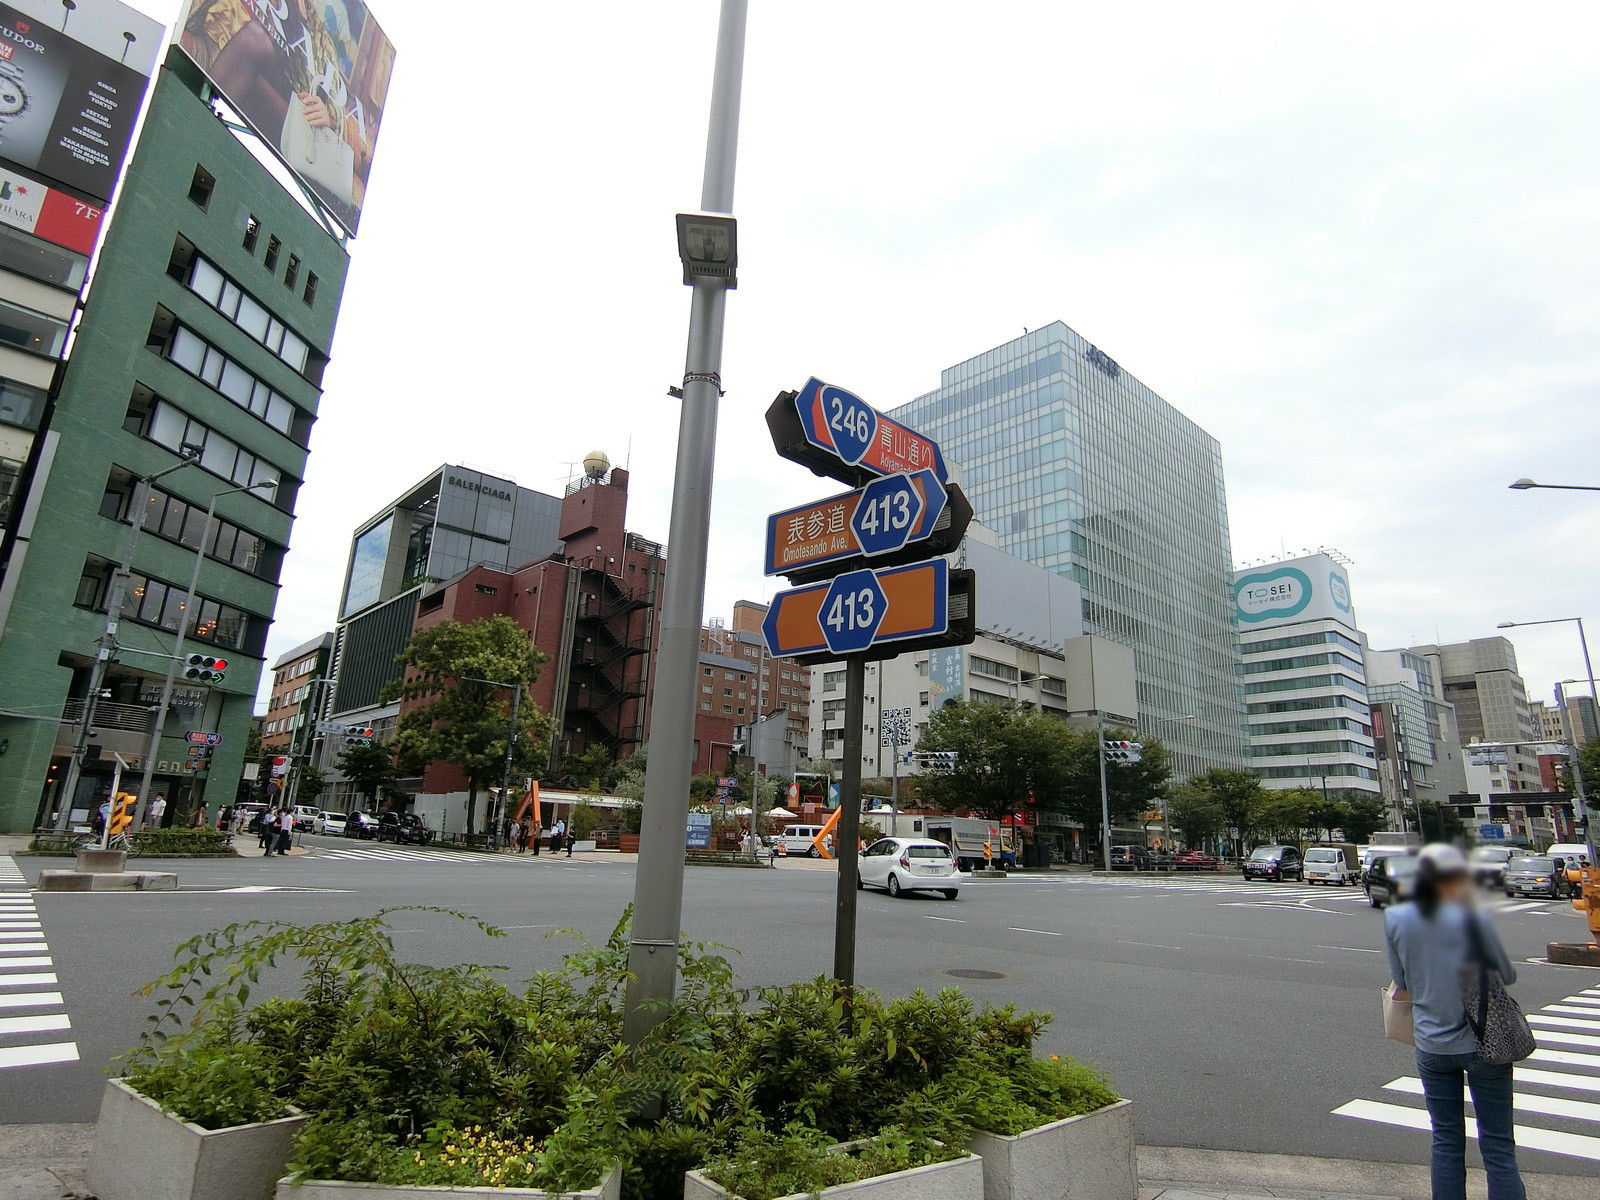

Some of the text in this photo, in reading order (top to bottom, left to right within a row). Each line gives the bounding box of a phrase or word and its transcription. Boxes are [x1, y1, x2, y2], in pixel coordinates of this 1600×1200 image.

[0, 25, 45, 54] UDOR
[244, 0, 290, 57] ALLERIA
[88, 90, 118, 108] DAIMARU
[97, 81, 117, 94] GINZA
[86, 108, 109, 122] ISETAN
[91, 97, 113, 110] TOKYO
[80, 111, 112, 129] SHINJUKU
[82, 126, 102, 138] SEIBU
[60, 140, 110, 166] WATCH MAISON
[63, 136, 109, 160] TAKASHIMAYA
[72, 151, 95, 165] TOKYO
[75, 201, 101, 220] 7F
[831, 397, 869, 443] 246
[880, 423, 932, 469] 青山通り
[880, 451, 918, 474] Aoyama-d
[448, 475, 511, 502] BALENCIAGA
[787, 503, 846, 545] 表参道
[861, 490, 910, 536] 413
[783, 536, 848, 563] Omotesando Ave.
[1247, 583, 1292, 600] TOSEI
[827, 588, 874, 632] 413
[148, 686, 202, 699] 工眼科
